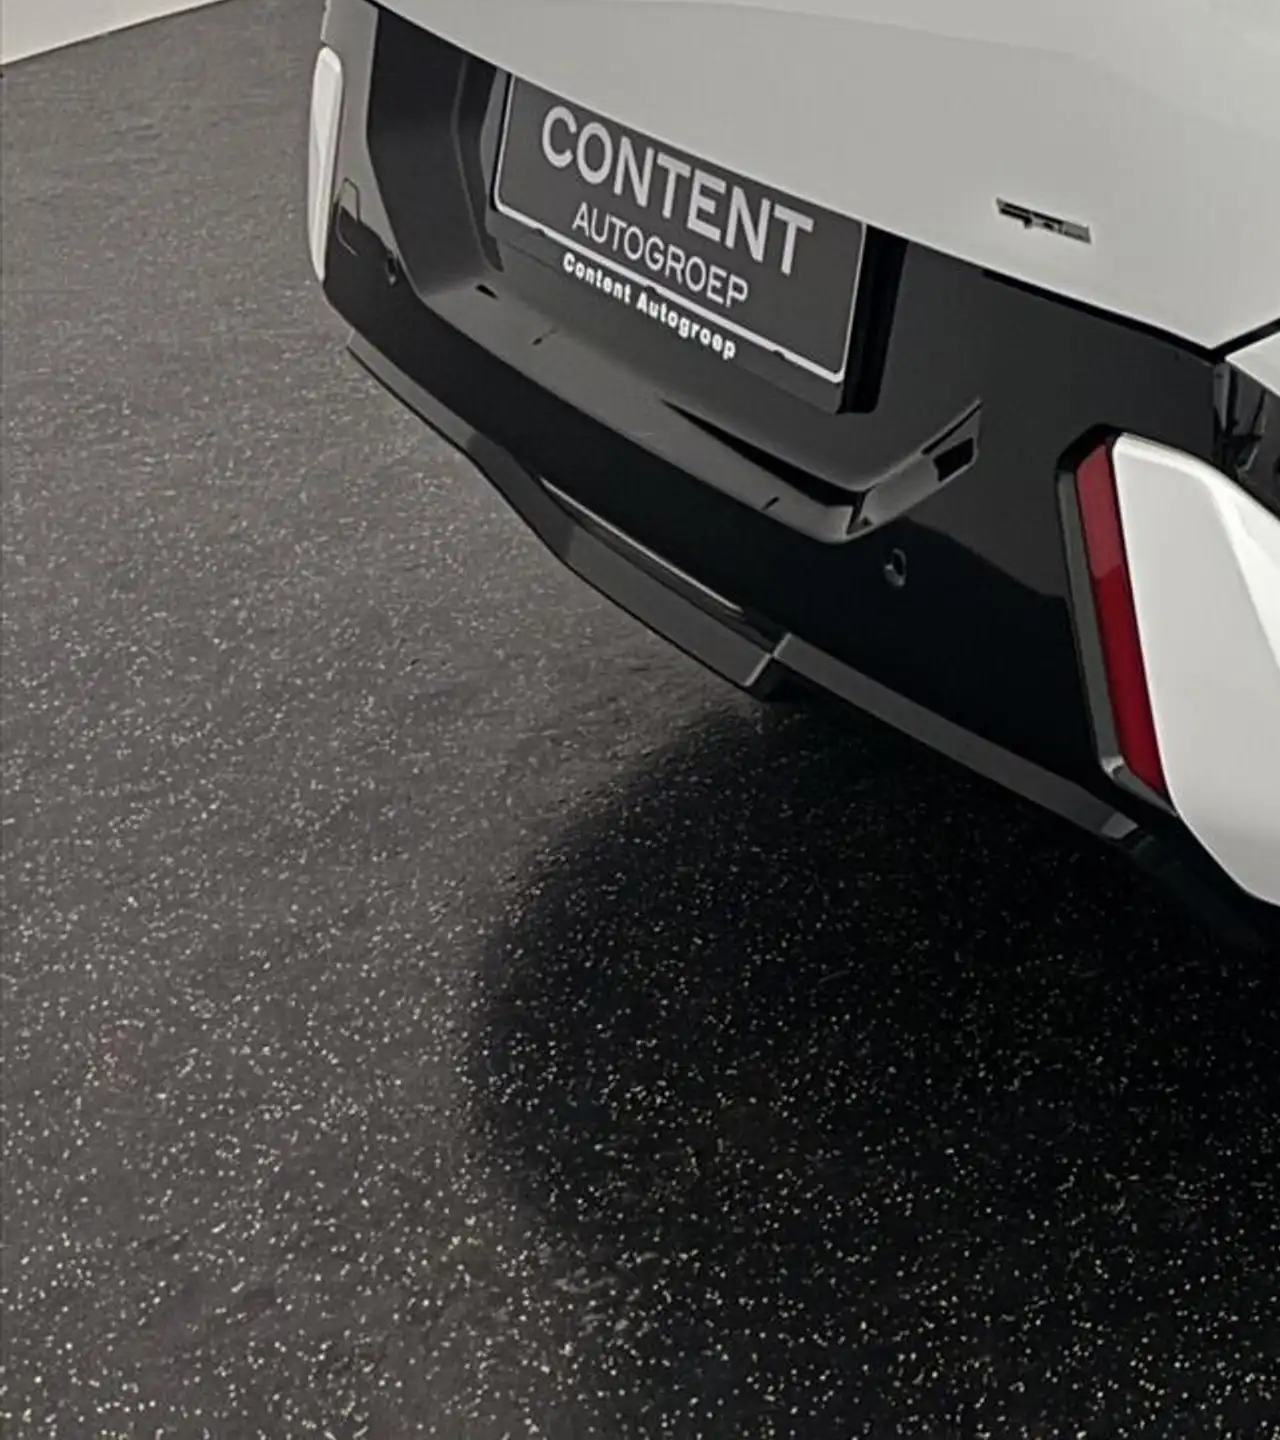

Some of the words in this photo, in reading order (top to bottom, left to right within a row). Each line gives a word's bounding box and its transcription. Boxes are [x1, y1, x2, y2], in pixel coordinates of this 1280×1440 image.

[541, 105, 815, 277] CONTENT
[562, 251, 632, 304] Content
[636, 291, 737, 360] Autogroep
[572, 201, 749, 309] AUTOGROEP
